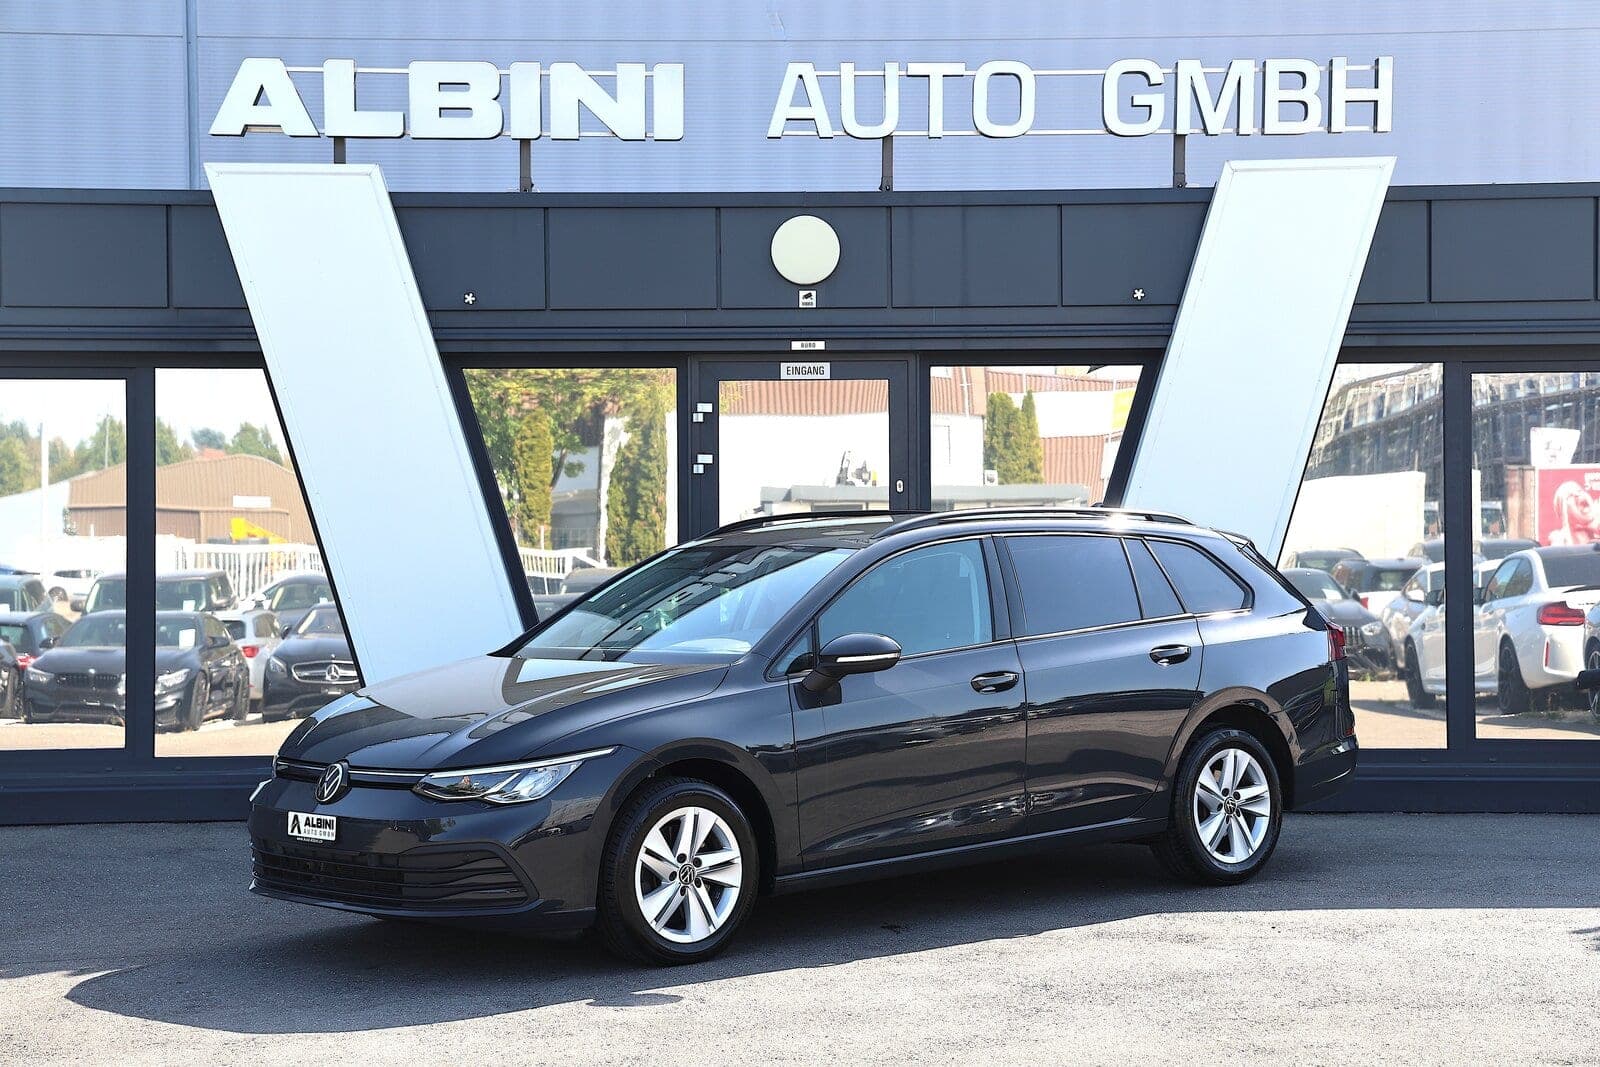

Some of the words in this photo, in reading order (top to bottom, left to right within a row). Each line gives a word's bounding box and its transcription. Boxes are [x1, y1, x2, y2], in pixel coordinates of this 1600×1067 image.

[209, 57, 685, 141] ALBINI
[766, 59, 1037, 139] AUTO
[1102, 55, 1395, 137] GMBH
[786, 366, 825, 376] EINGANG
[303, 816, 335, 831] ALBINI
